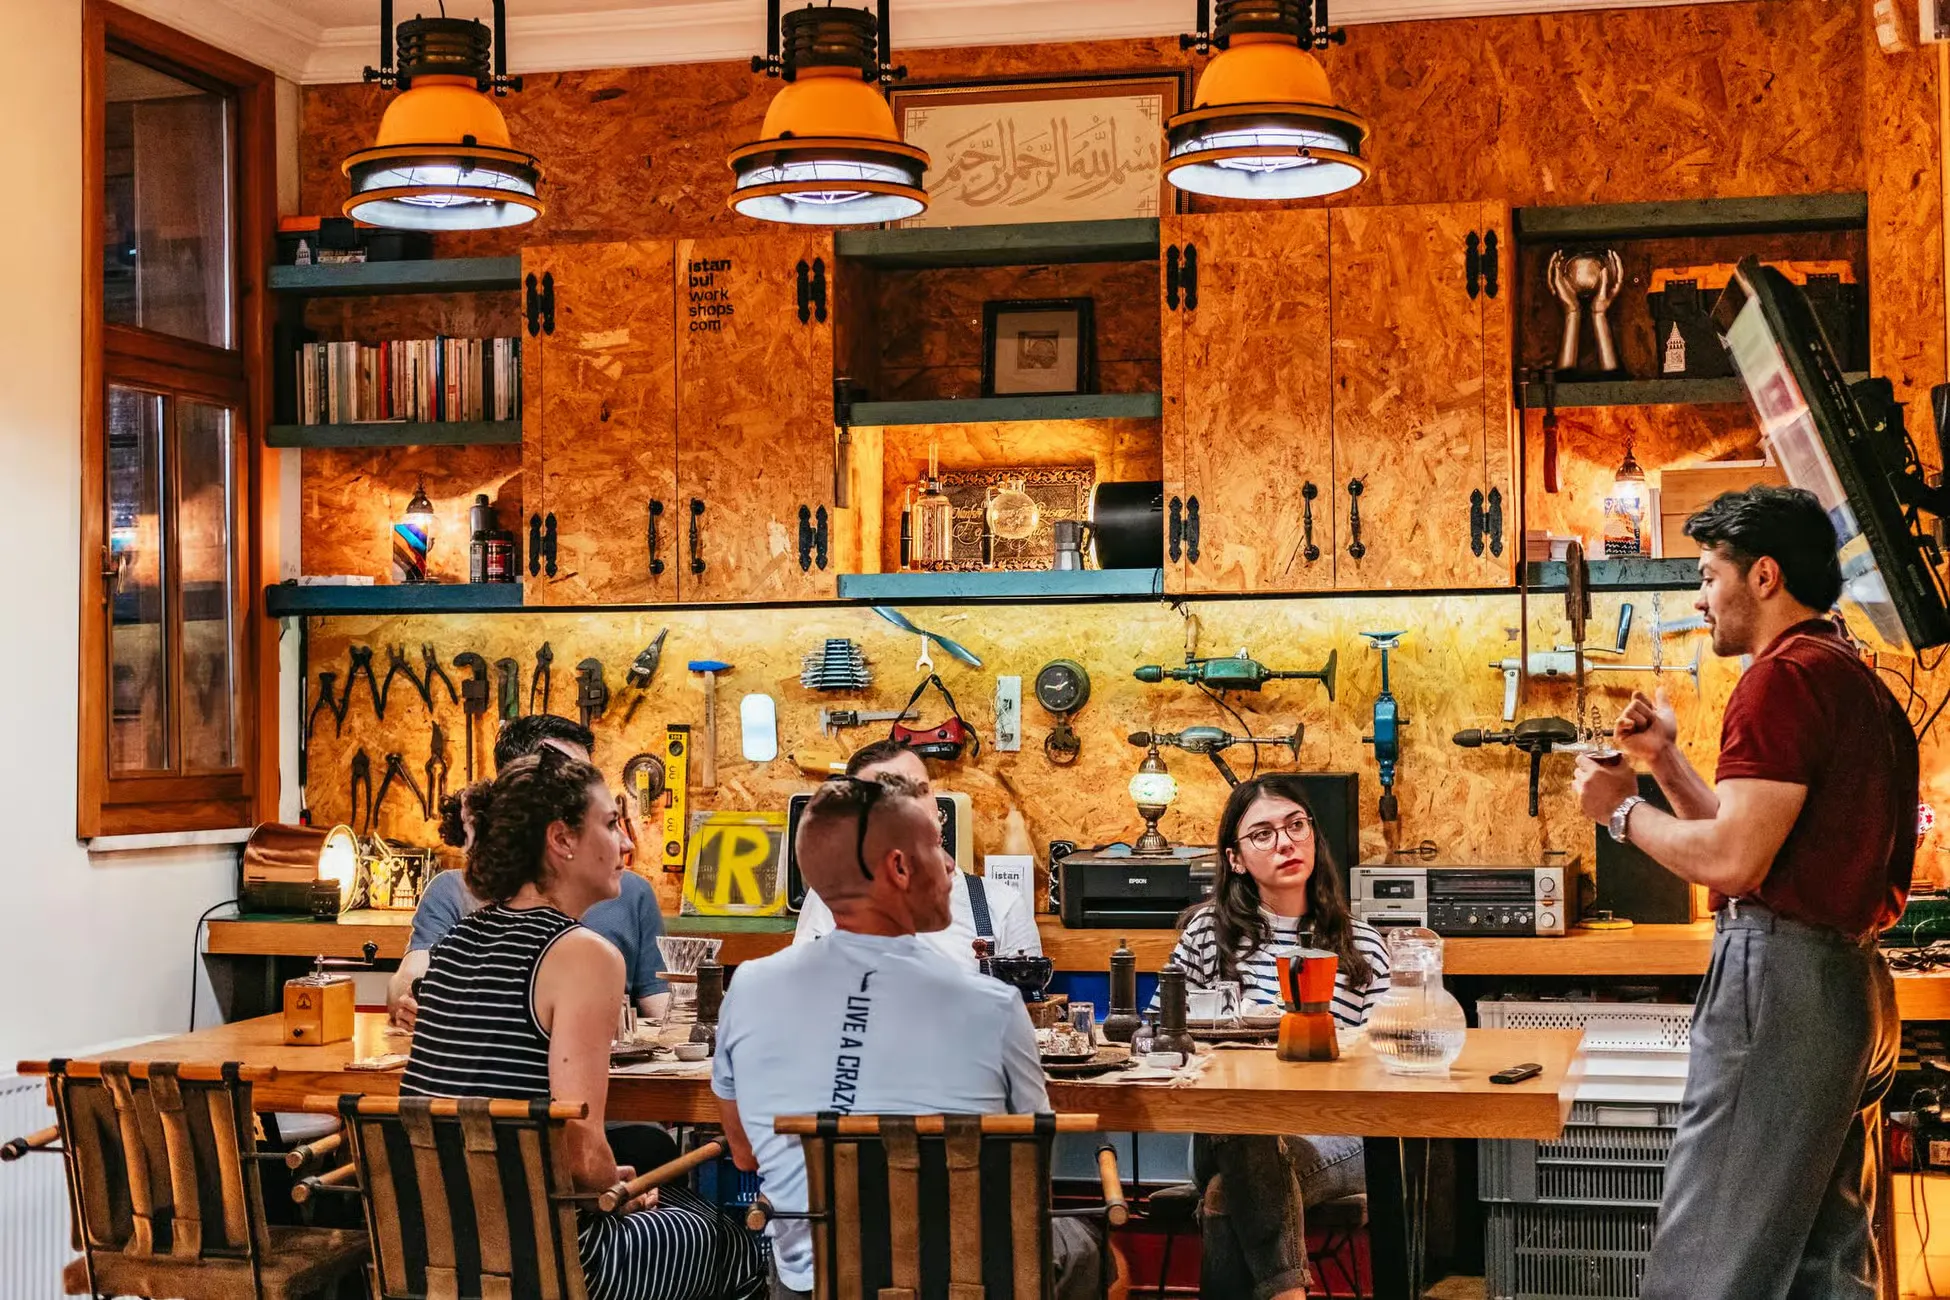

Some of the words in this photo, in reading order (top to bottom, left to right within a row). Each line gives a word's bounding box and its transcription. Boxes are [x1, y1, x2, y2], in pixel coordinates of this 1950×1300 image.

[688, 258, 731, 272] istan
[689, 272, 713, 287] bul
[689, 287, 728, 301] work
[689, 303, 734, 318] shops
[689, 320, 720, 331] com
[714, 826, 770, 905] R
[995, 872, 1019, 880] istan
[843, 996, 871, 1033] LIVE
[840, 1037, 863, 1048] A
[830, 1055, 861, 1116] CRAZY
